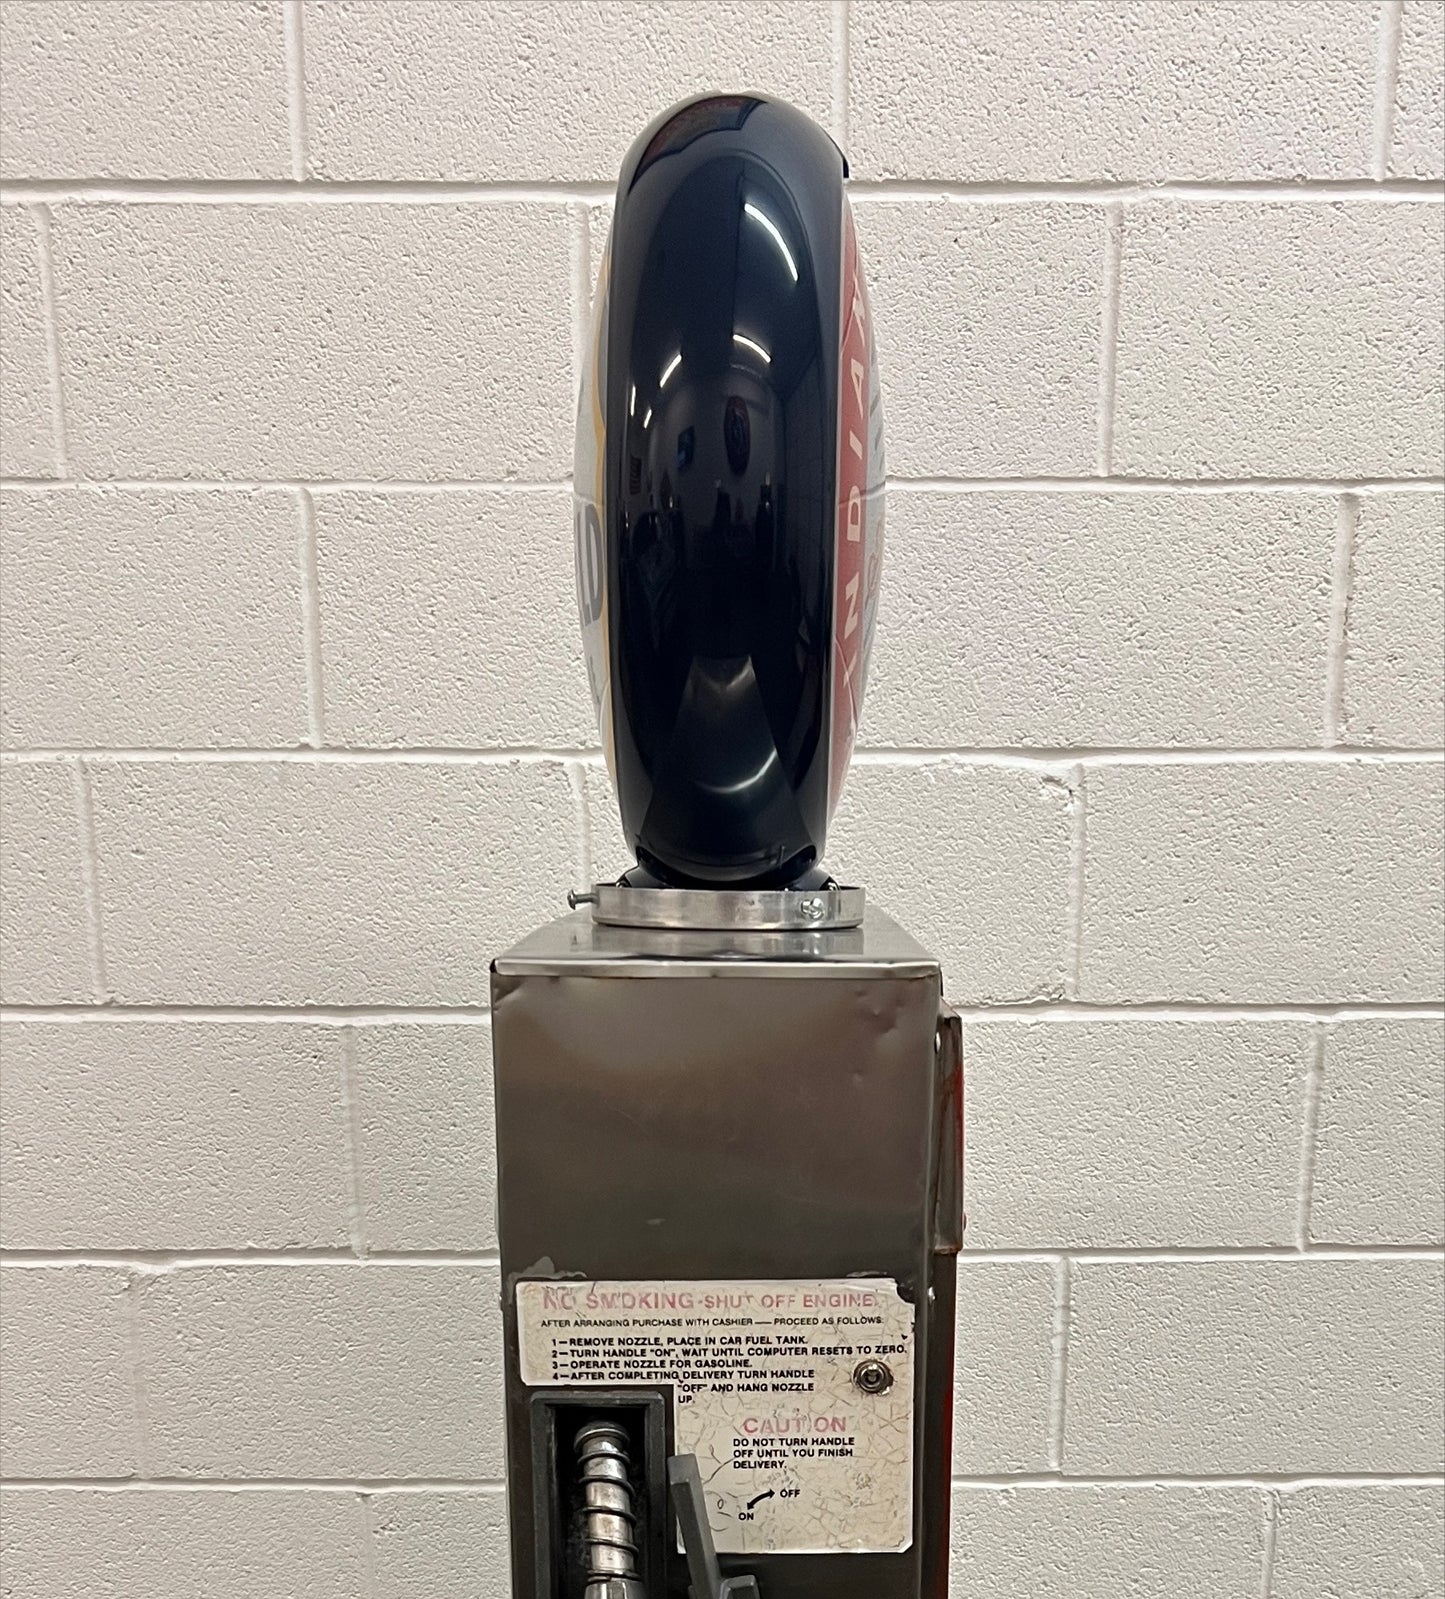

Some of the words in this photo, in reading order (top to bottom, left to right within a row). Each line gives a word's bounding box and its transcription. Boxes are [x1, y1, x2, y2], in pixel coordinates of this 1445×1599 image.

[761, 1294, 796, 1308] OFF
[541, 1319, 571, 1328] AFTER
[573, 1319, 630, 1328] ARRANGING
[632, 1318, 683, 1327] PURCHASE
[685, 1318, 709, 1327] WITH
[712, 1317, 753, 1326] CASHIER
[773, 1317, 819, 1326] PROCEED
[821, 1317, 834, 1325] AS
[617, 1336, 664, 1347] NOZZLE,
[667, 1336, 702, 1346] PLACE
[705, 1336, 717, 1346] IN
[720, 1336, 742, 1345] CAR
[745, 1335, 773, 1345] FUEL
[776, 1335, 808, 1345] TANK.
[602, 1348, 647, 1358] HANDLE
[682, 1348, 709, 1358] WAIT
[711, 1347, 744, 1357] UNTIL
[747, 1347, 808, 1356] COMPUTER
[811, 1346, 853, 1355] RESETS
[856, 1345, 871, 1354] TO
[874, 1344, 908, 1354] ZERO.
[623, 1359, 667, 1369] NOZZLE
[669, 1359, 692, 1369] FOR
[694, 1358, 754, 1369] GASOLINE.
[607, 1370, 680, 1381] COMPLETING
[682, 1370, 735, 1380] DELIVERY
[737, 1370, 768, 1379] TURN
[770, 1369, 816, 1378] HANDLE
[710, 1383, 734, 1392] AND
[737, 1383, 769, 1392] HANG
[771, 1382, 815, 1391] NOZZLE
[743, 1416, 848, 1434] CAUTON
[733, 1438, 749, 1447] DO
[752, 1438, 776, 1447] NOT
[778, 1437, 808, 1446] TURN
[811, 1437, 856, 1446] HANDLE
[733, 1449, 754, 1458] OFF
[757, 1449, 790, 1458] UNTIL
[793, 1448, 816, 1457] YOU
[818, 1448, 854, 1457] FINISH
[733, 1460, 788, 1470] DELIVERY.
[779, 1488, 801, 1498] OFF
[738, 1512, 755, 1521] ON
